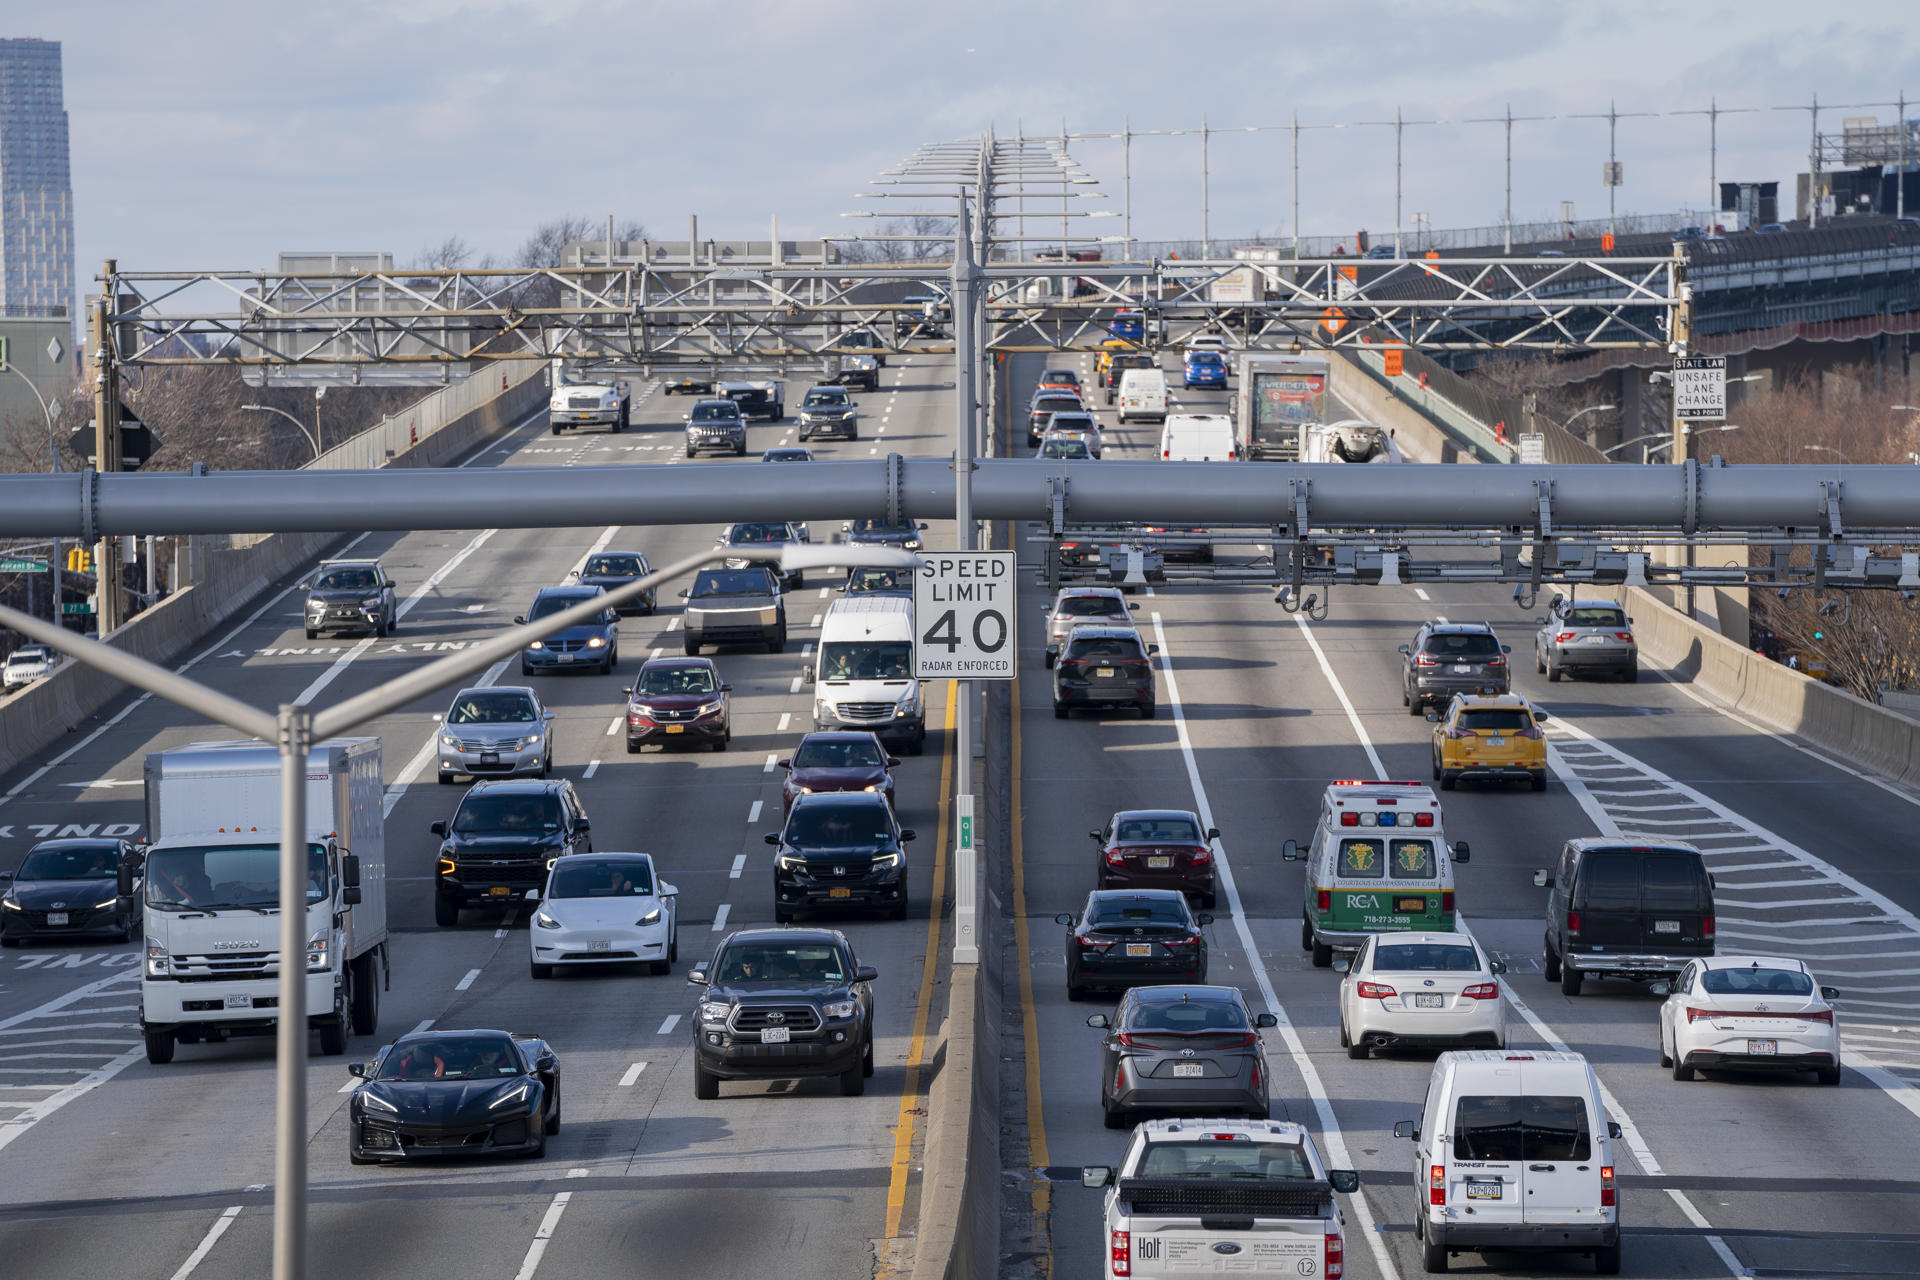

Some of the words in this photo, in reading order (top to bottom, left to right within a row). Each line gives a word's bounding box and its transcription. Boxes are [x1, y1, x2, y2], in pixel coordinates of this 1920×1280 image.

[1676, 359, 1703, 368] STATE
[1706, 359, 1725, 368] LAW
[1678, 372, 1722, 382] UNSAFE
[1685, 384, 1715, 394] LANE
[1677, 394, 1723, 405] CHANGE
[922, 559, 1005, 578] SPEED
[932, 583, 997, 602] LIMIT
[922, 609, 1007, 654] 40
[921, 661, 953, 671] RADAR
[957, 660, 1008, 671] ENFORCED
[1346, 894, 1380, 909] RCA
[214, 940, 260, 949] ISUZU
[1138, 1237, 1162, 1259] Holt
[1300, 1261, 1314, 1273] 12
